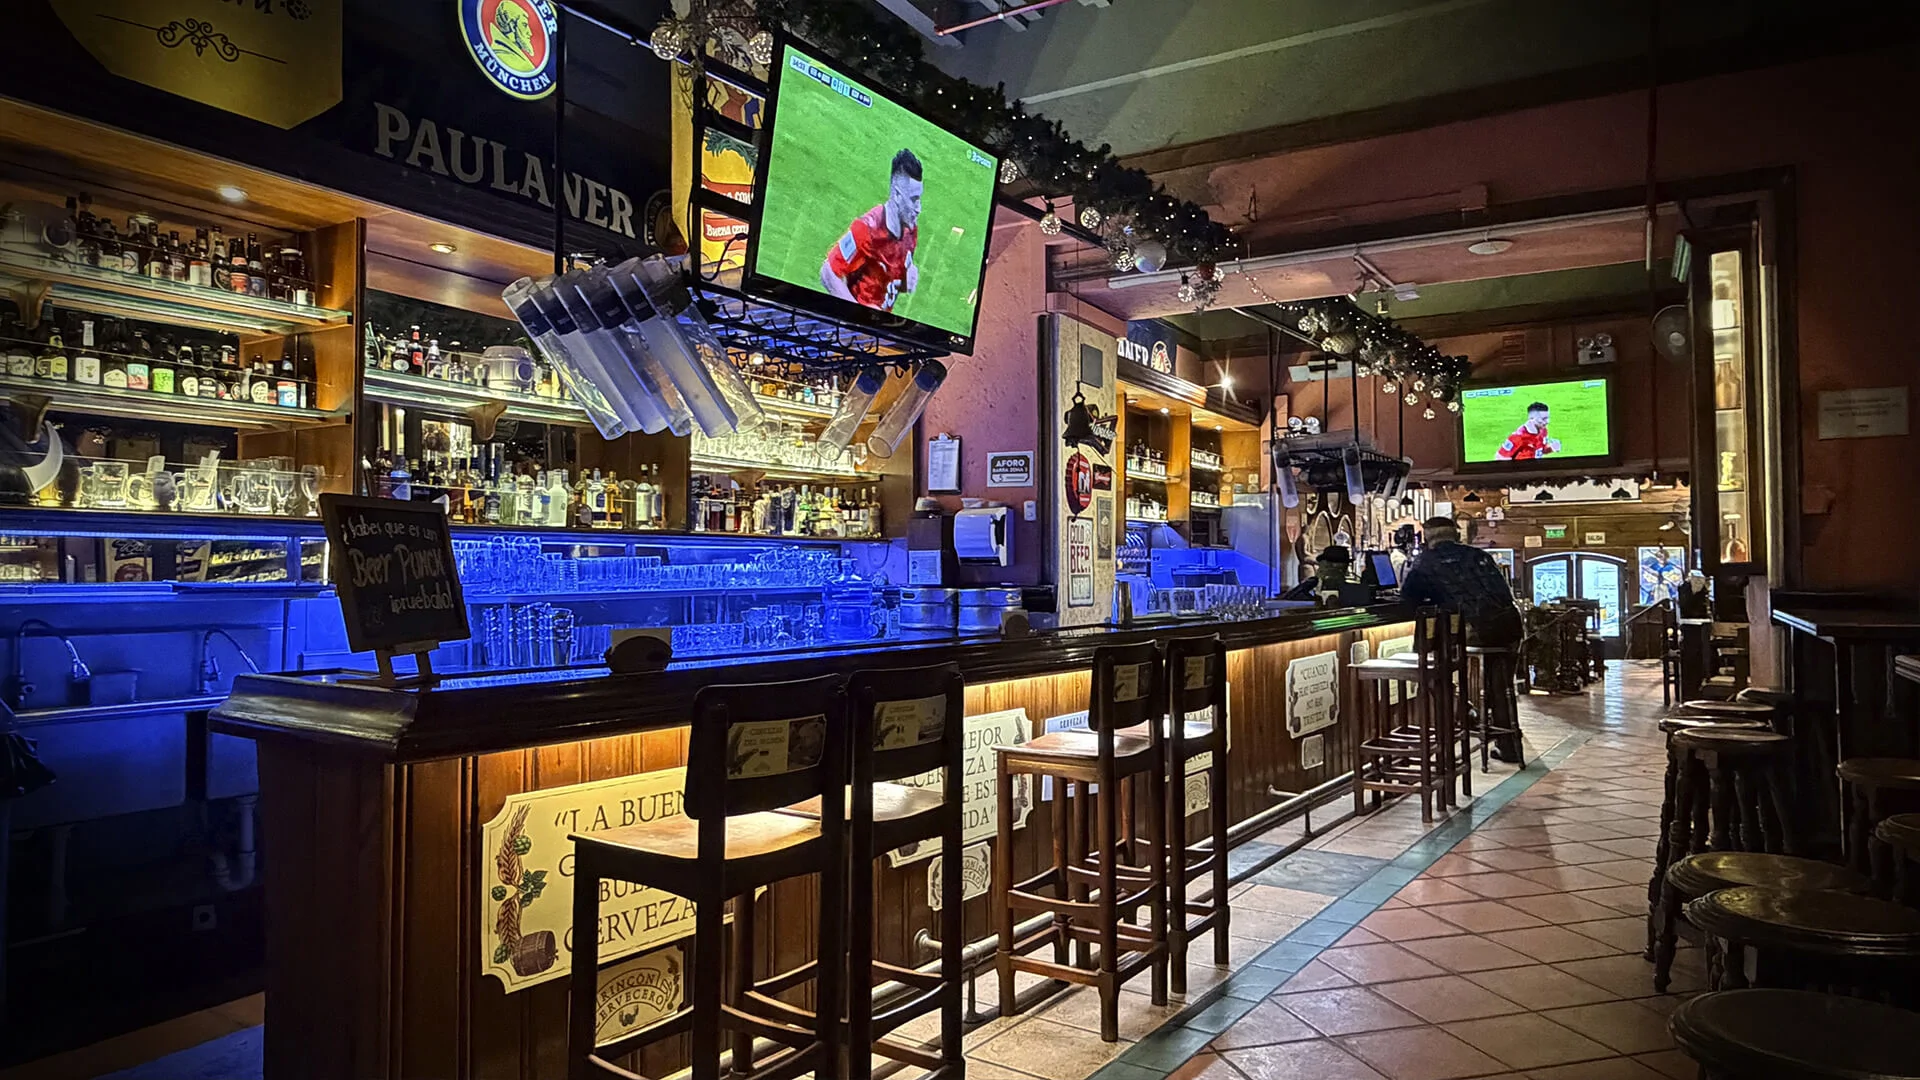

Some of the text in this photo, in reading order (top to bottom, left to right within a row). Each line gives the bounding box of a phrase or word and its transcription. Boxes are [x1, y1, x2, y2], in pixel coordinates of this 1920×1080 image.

[474, 42, 551, 91] MÜNCHEN
[373, 101, 636, 239] PAULANER
[995, 459, 1025, 468] AFORO
[1070, 525, 1084, 544] COLD
[350, 548, 392, 587] Beer
[1070, 545, 1090, 573] BEER
[1060, 716, 1082, 729] CERVEZA
[976, 778, 998, 801] EST
[619, 790, 686, 827] BUEN
[964, 805, 996, 831] IDA”
[597, 989, 664, 1026] ERVECERO
